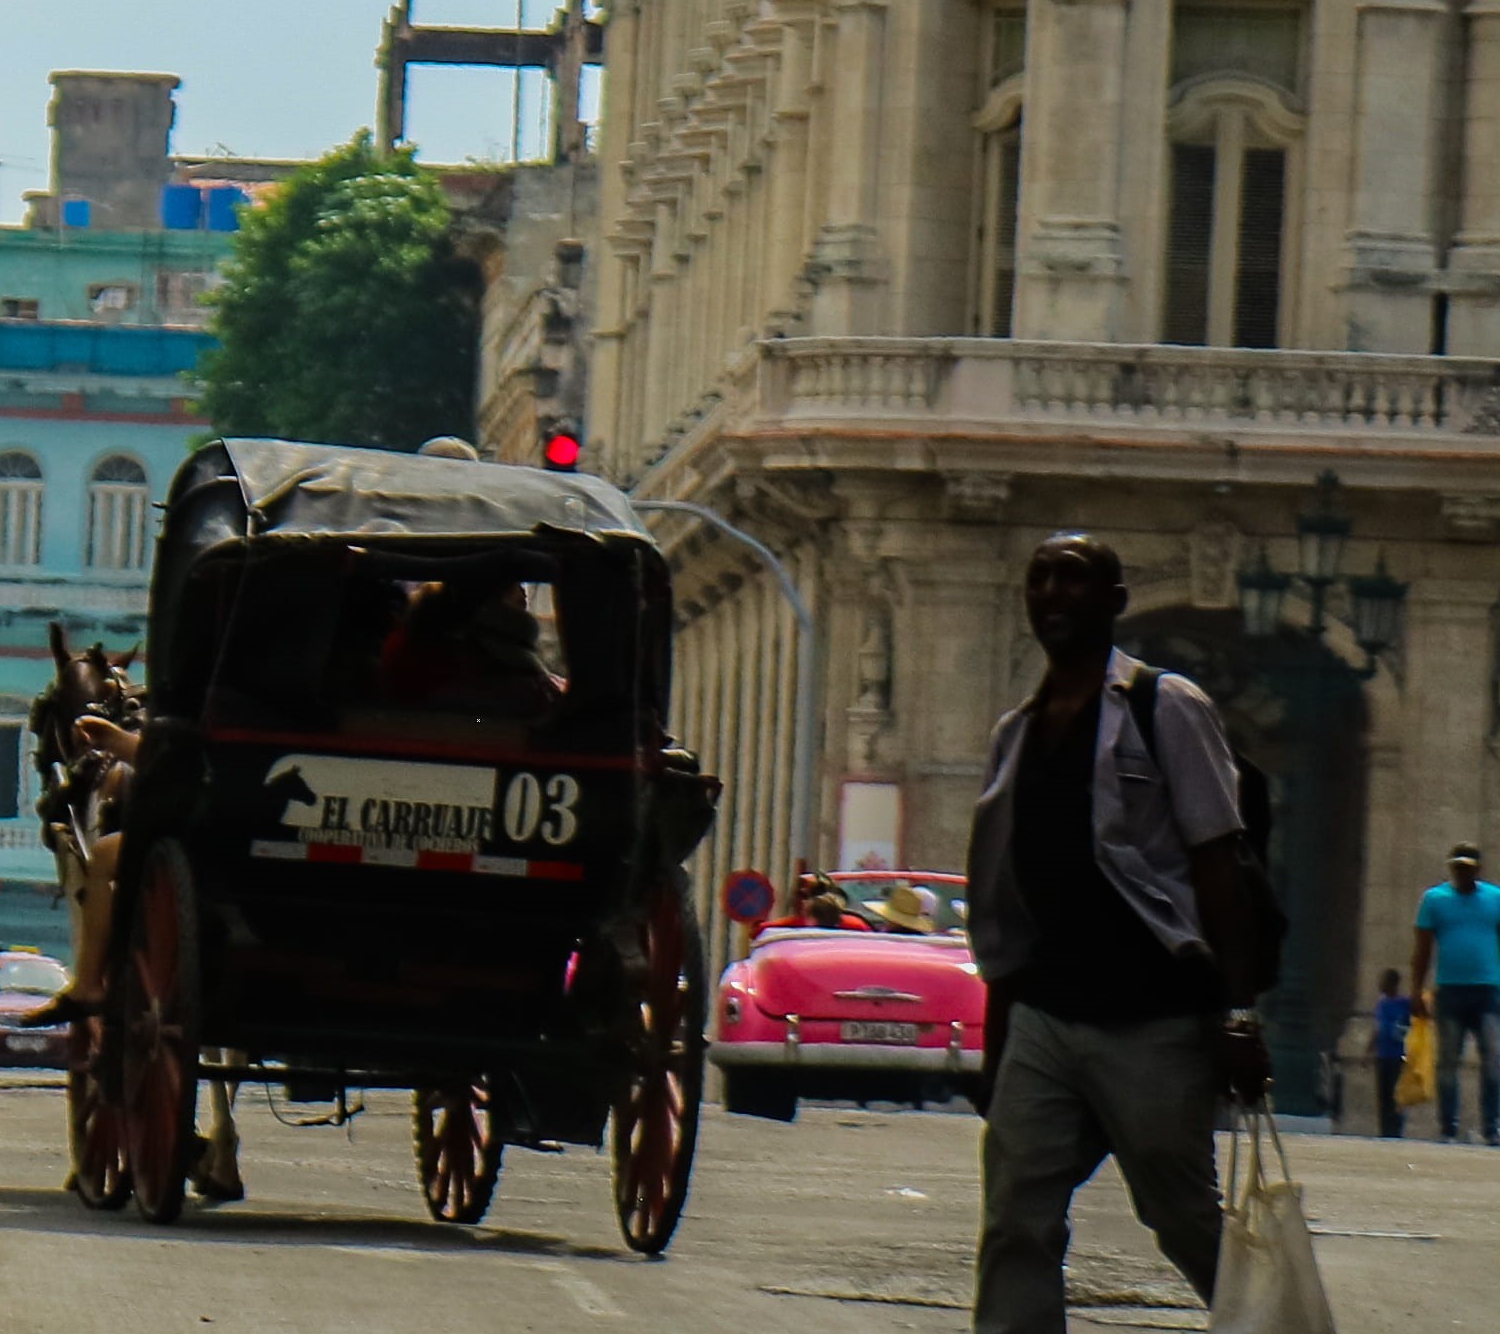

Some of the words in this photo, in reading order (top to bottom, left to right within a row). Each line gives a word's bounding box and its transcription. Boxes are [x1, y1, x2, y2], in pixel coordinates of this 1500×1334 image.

[322, 795, 350, 831] EL
[361, 798, 496, 843] CARRUAJE
[502, 771, 581, 846] 03
